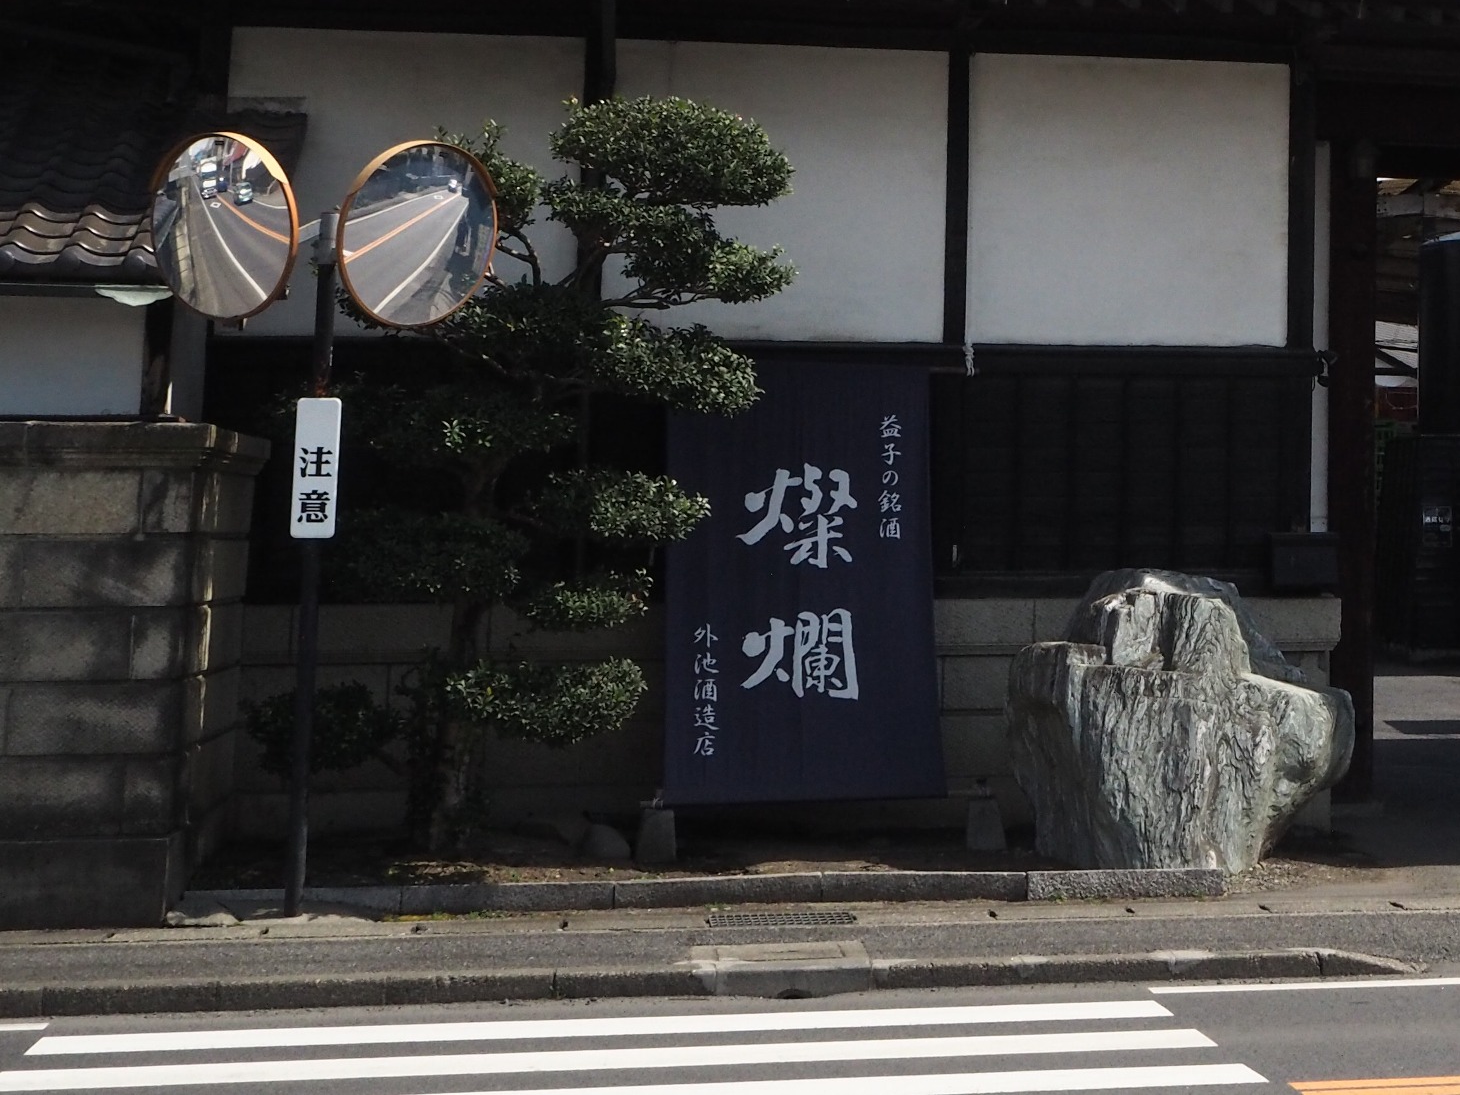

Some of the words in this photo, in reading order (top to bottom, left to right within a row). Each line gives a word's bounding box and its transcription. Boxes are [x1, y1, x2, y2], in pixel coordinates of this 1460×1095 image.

[297, 446, 335, 524] 注意
[877, 414, 902, 540] 益子の銘酒
[736, 462, 859, 701] 燦爛
[693, 623, 720, 757] 外池酒造店
